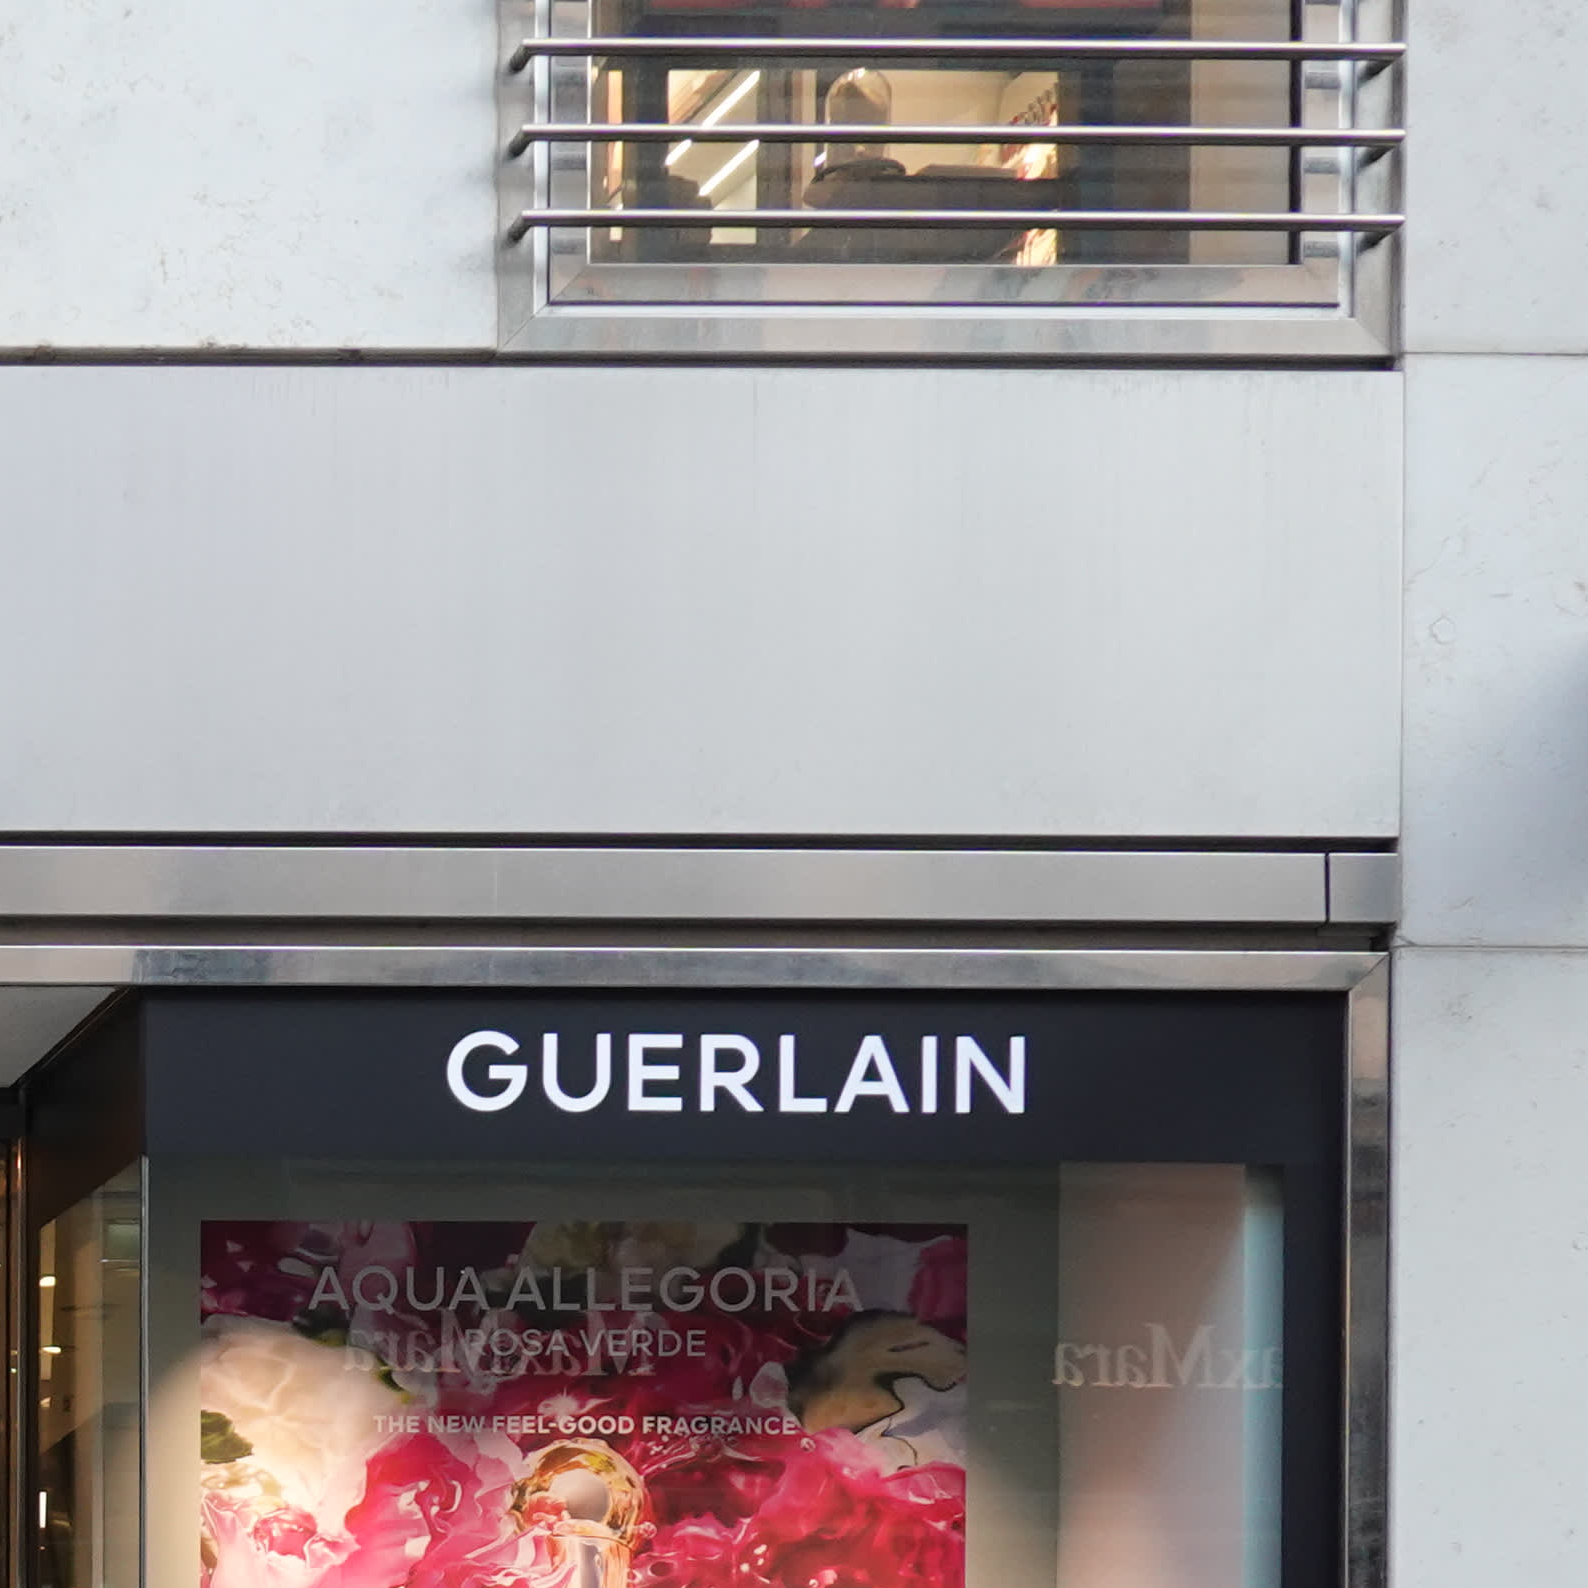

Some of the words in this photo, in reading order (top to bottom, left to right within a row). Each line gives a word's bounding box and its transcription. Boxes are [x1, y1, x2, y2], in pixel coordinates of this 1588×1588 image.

[445, 1029, 1028, 1116] GUERLAIN
[308, 1265, 490, 1314] AQUA
[504, 1265, 863, 1314] ALLEGORIA
[466, 1329, 570, 1358] ROSA
[582, 1329, 707, 1358] VERDE
[373, 1415, 420, 1436] THE
[426, 1415, 488, 1436] NEW
[492, 1415, 635, 1436] FEEL-GOOD
[642, 1415, 798, 1436] FRAGRANCE
